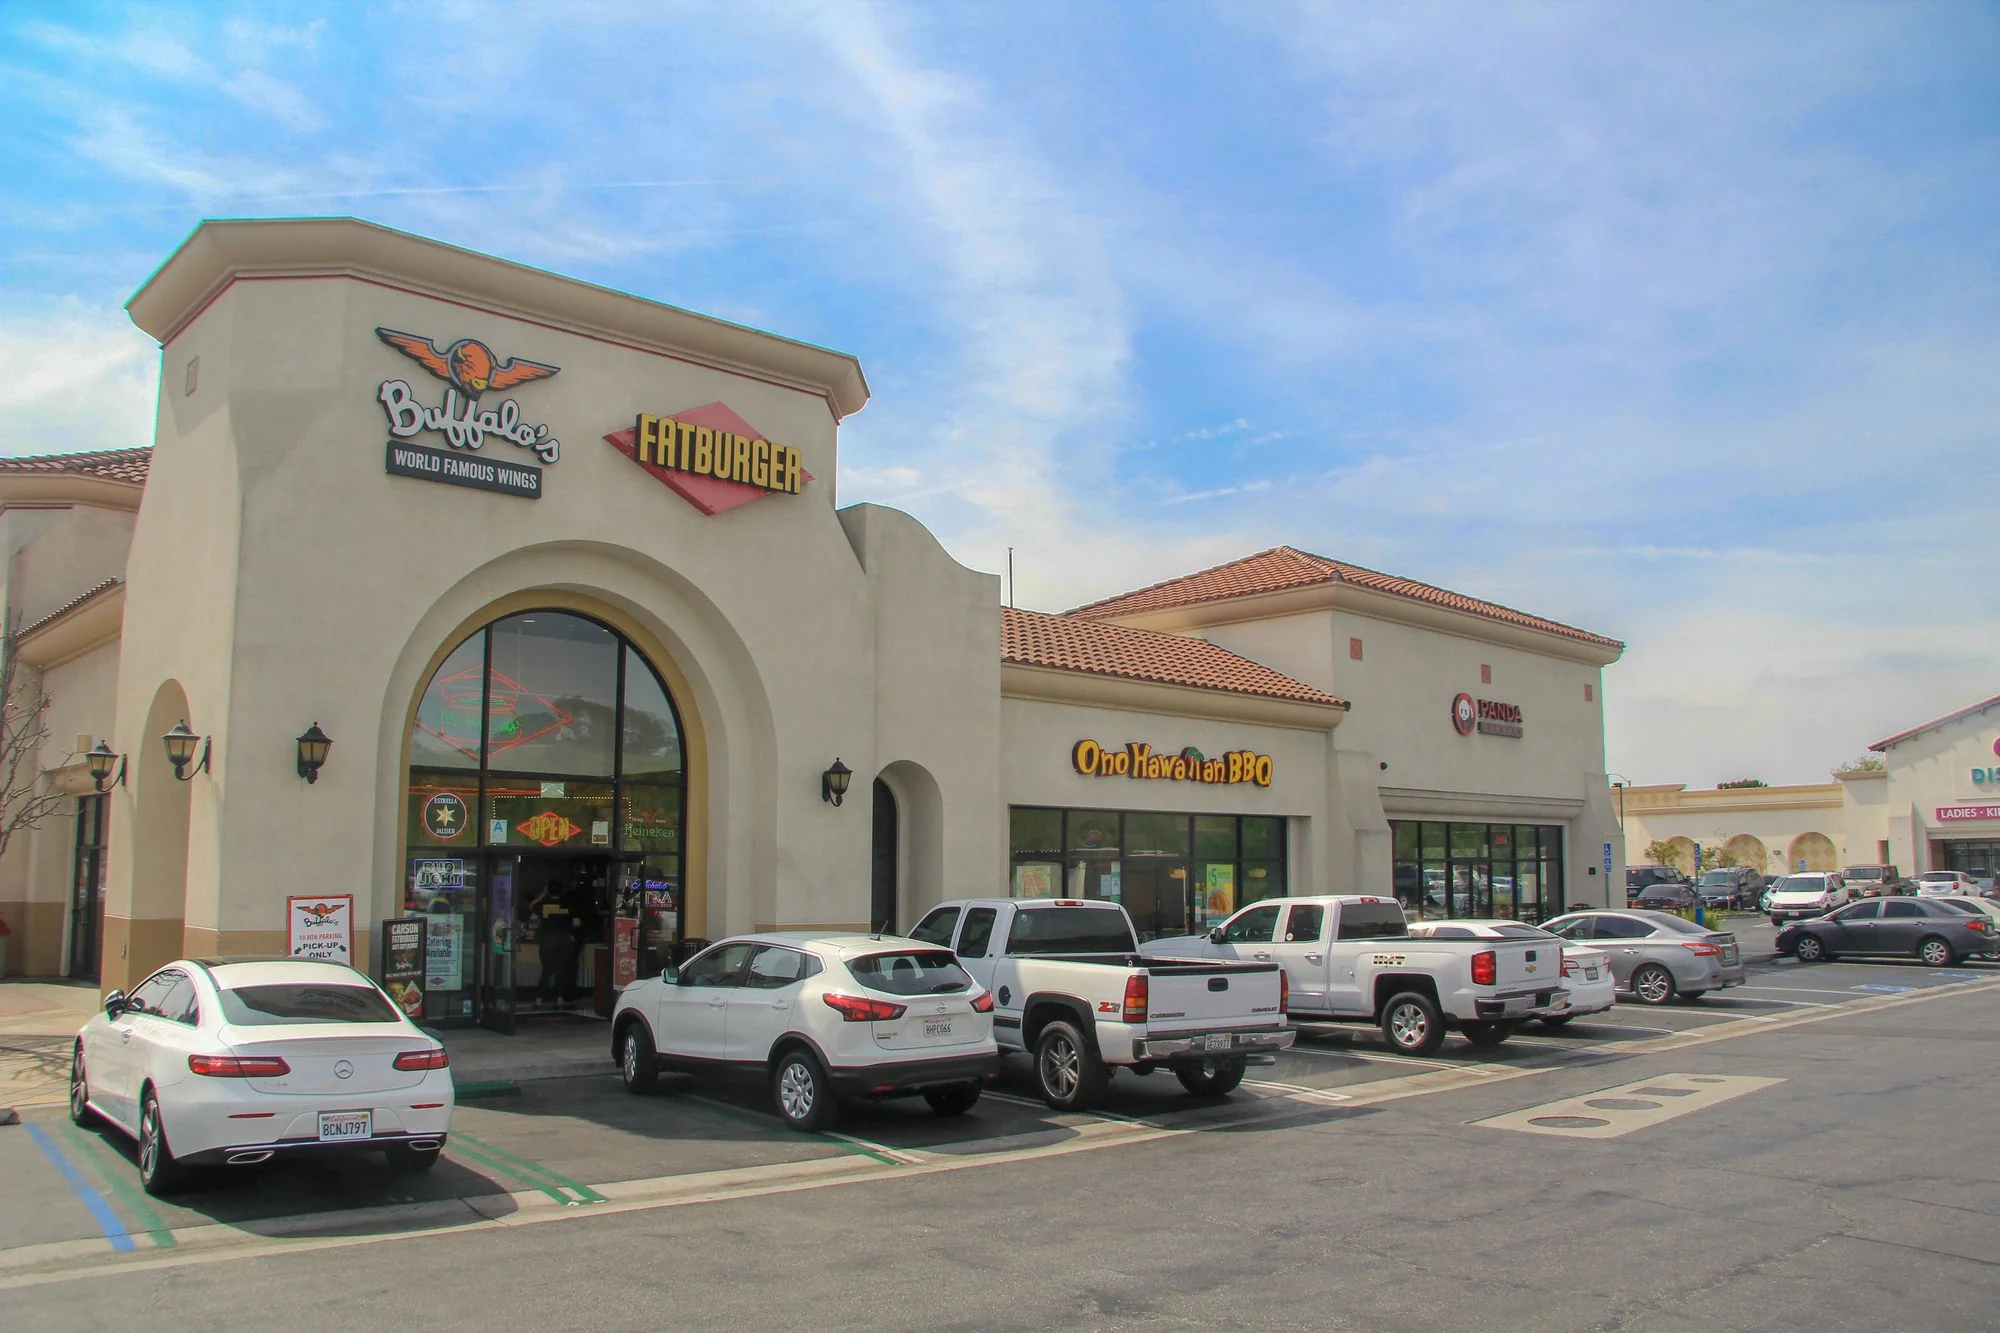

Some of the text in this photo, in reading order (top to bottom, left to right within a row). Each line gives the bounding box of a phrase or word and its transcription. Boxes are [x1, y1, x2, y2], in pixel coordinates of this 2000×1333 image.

[378, 379, 561, 465] Buffalo's
[635, 412, 801, 495] FATBURGER
[394, 448, 537, 491] WORLD FAMOUS WINGS
[1477, 699, 1523, 723] PANDA
[1072, 739, 1130, 776] Ono
[1223, 750, 1273, 787] BBQ
[1940, 807, 2000, 819] LADIES KI
[435, 827, 456, 835] JALISCO
[493, 821, 504, 832] A
[530, 815, 570, 841] OPEN
[624, 823, 675, 838] Heineken
[422, 861, 455, 873] BUD
[416, 872, 460, 886] LIGHT
[391, 923, 419, 935] CARSON
[307, 933, 318, 941] MIN
[319, 932, 343, 940] PARKING
[302, 942, 339, 950] PICK-UP
[309, 951, 333, 959] ONLY
[322, 1121, 367, 1136] 8CNJ797
